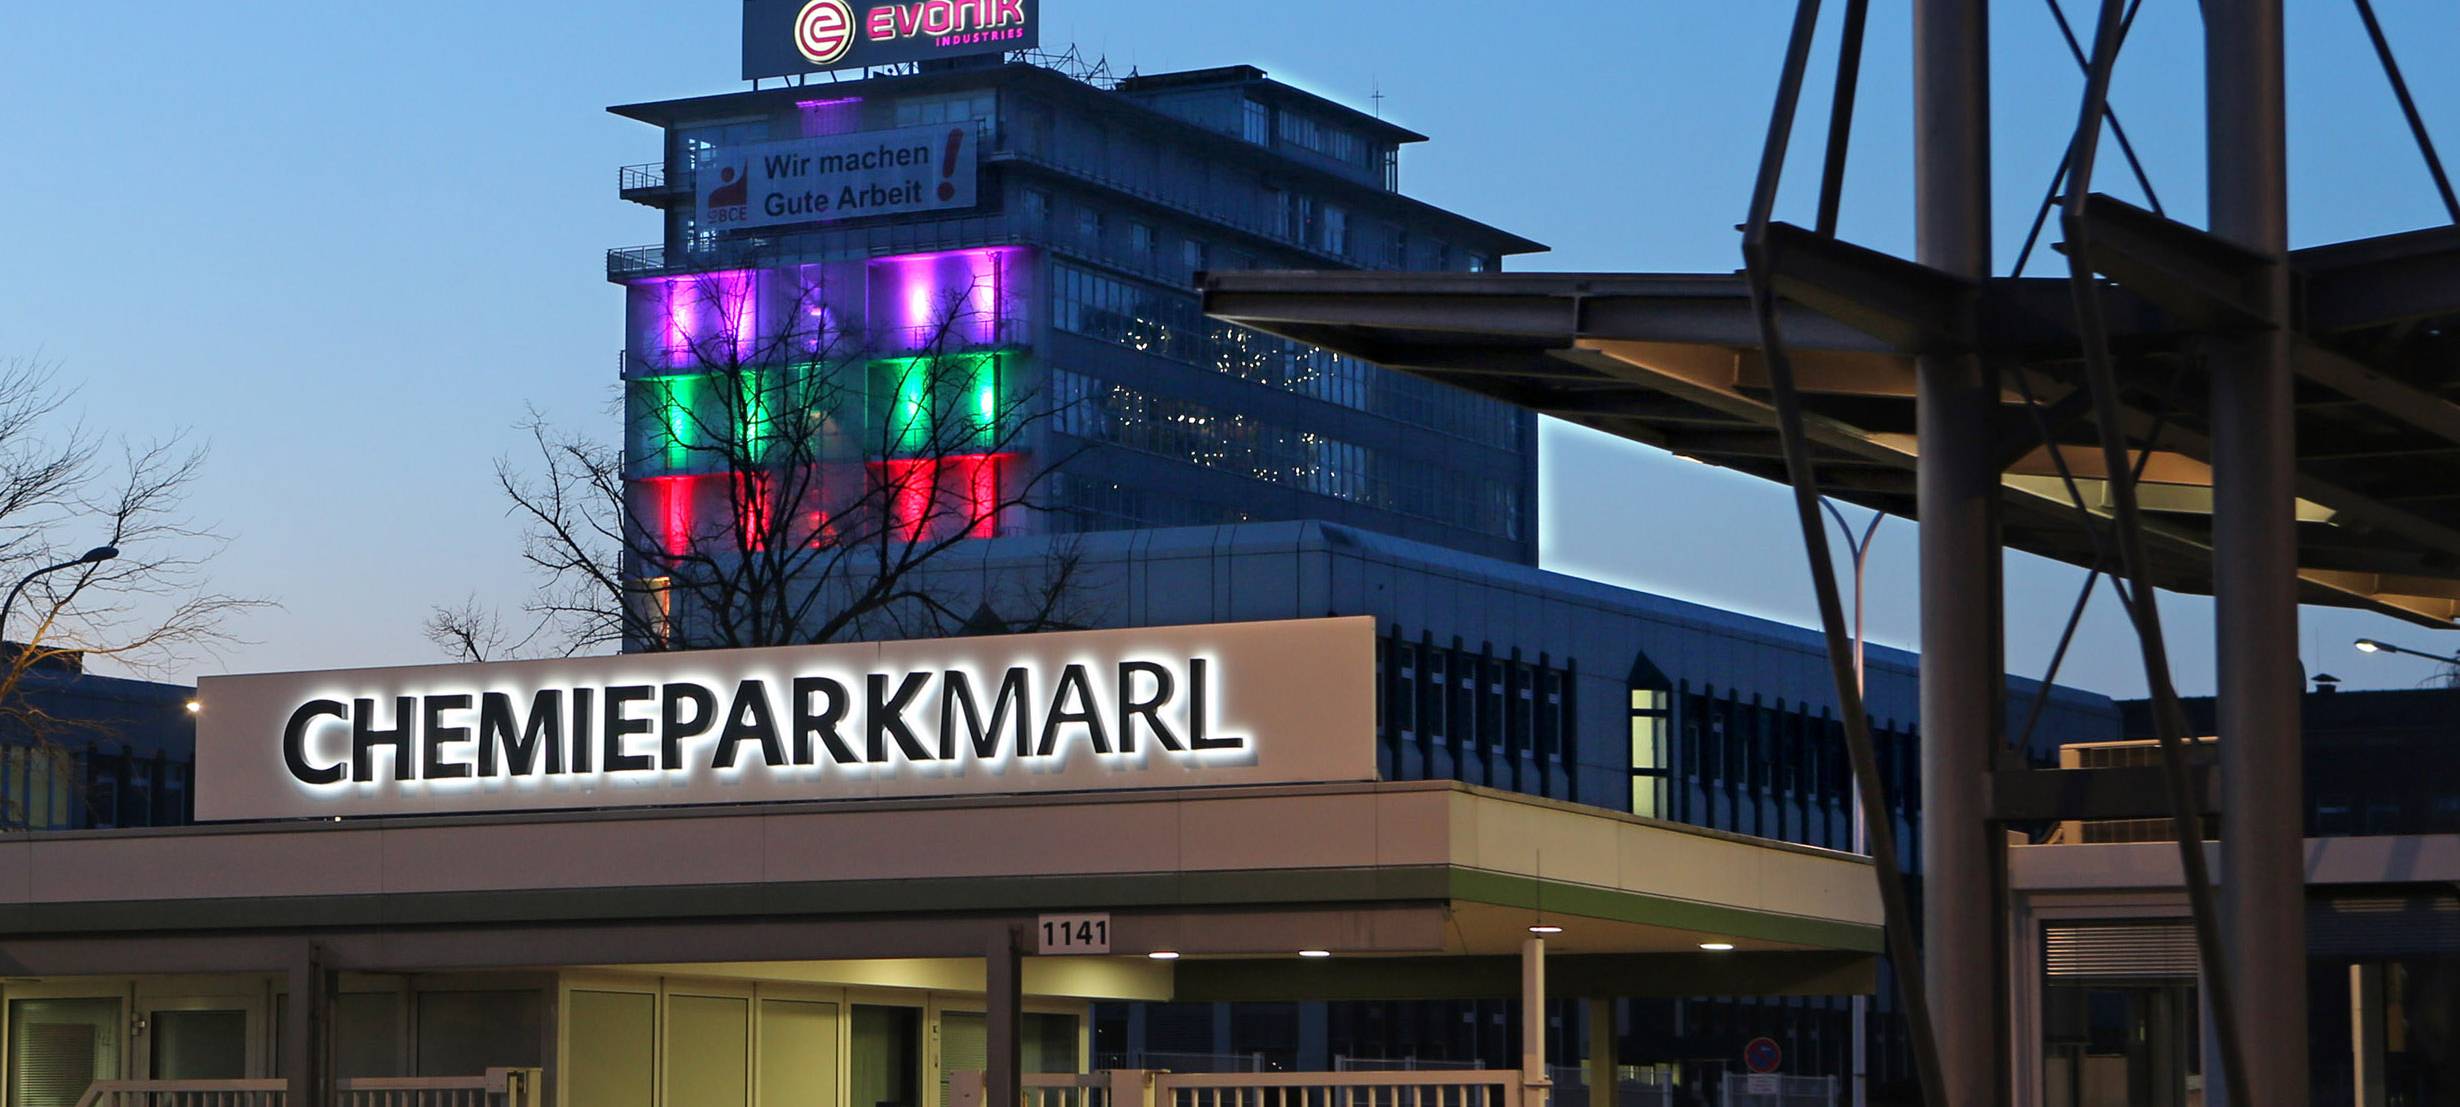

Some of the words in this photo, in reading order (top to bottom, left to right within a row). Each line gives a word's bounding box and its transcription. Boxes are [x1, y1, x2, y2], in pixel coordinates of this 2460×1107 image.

[936, 27, 1024, 48] INDUSTRIES
[764, 155, 811, 179] Wir
[819, 143, 929, 175] machen
[764, 191, 829, 217] Gute
[837, 180, 922, 209] Arbeit
[283, 657, 1243, 785] CHEMIEPARKMARL
[1043, 921, 1106, 946] 1141
